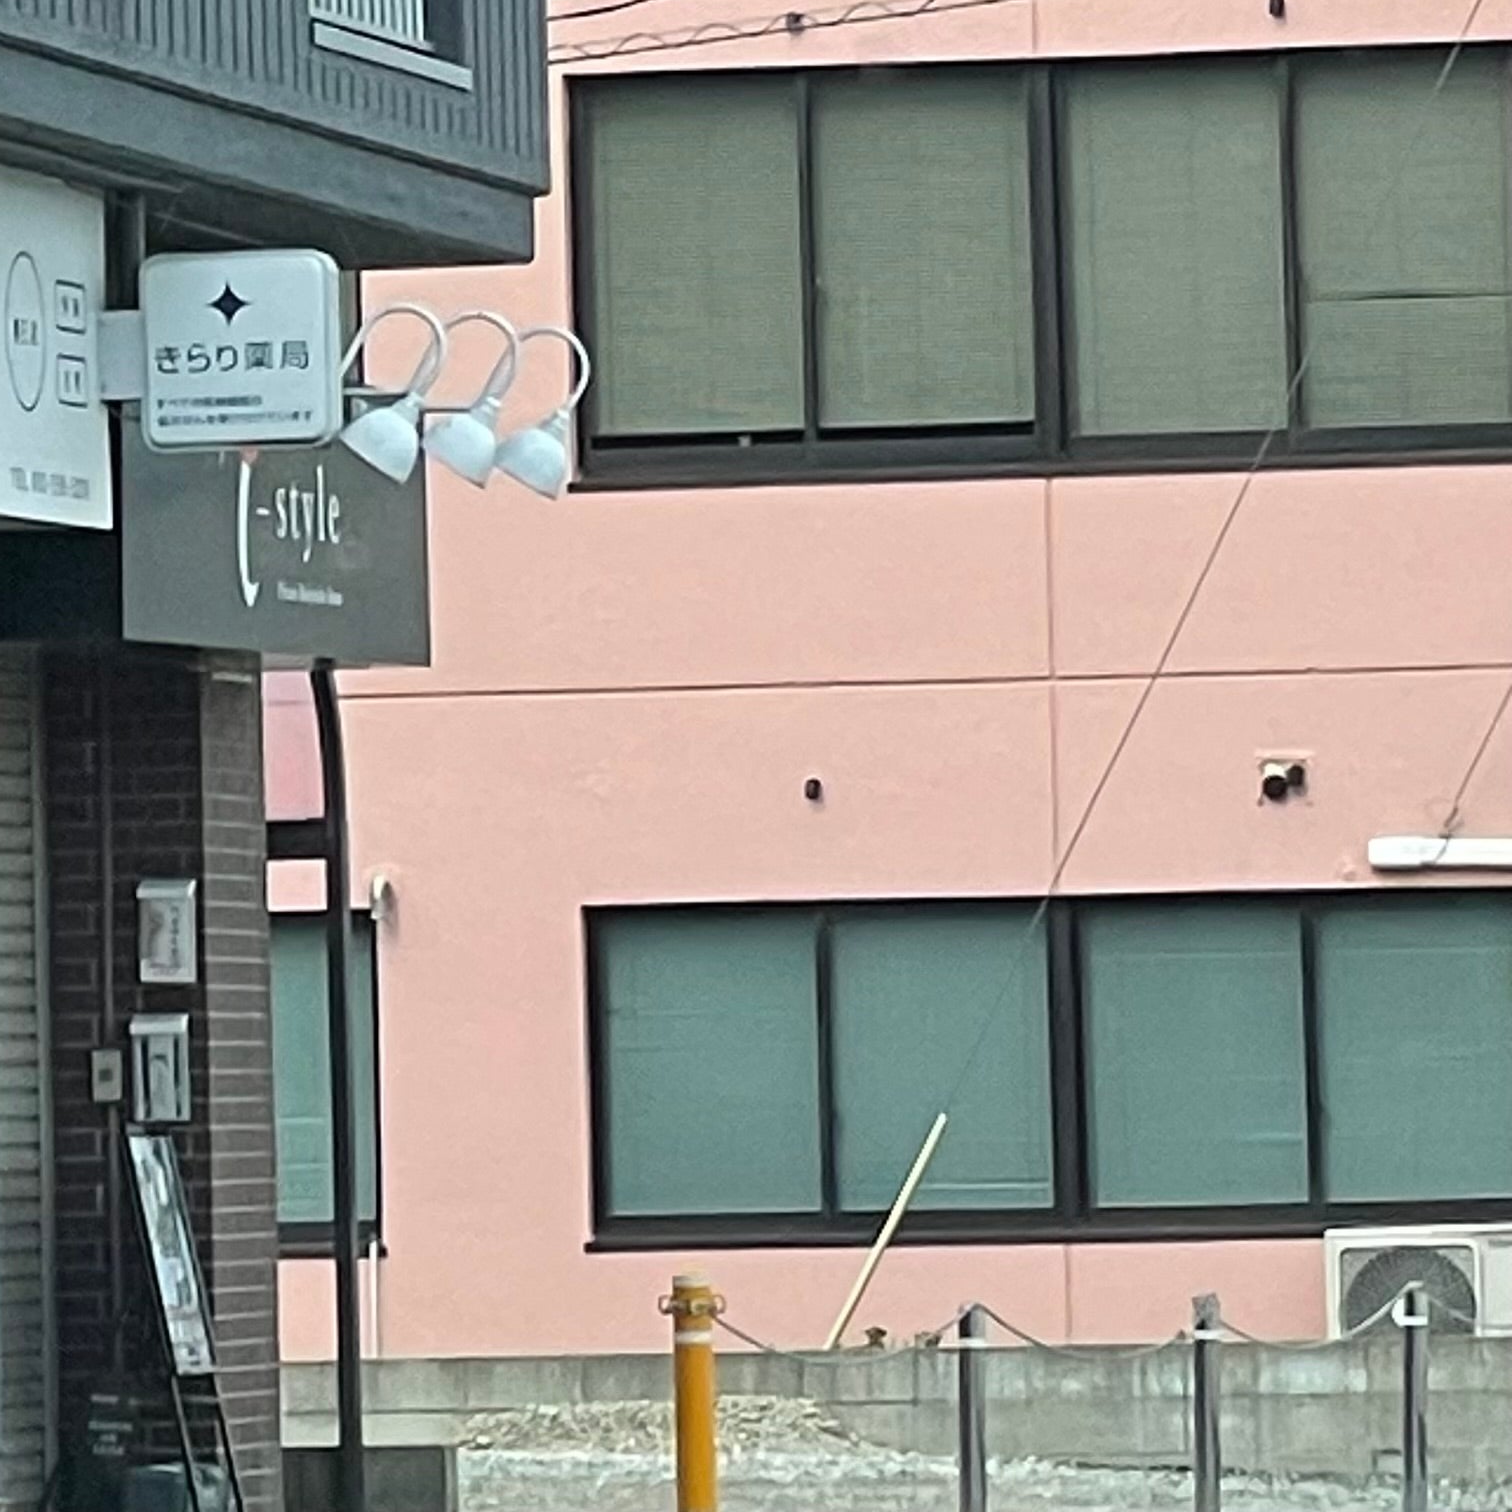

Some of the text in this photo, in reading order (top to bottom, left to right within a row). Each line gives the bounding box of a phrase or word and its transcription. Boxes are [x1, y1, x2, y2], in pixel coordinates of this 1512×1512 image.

[154, 340, 309, 374] きらり薬局
